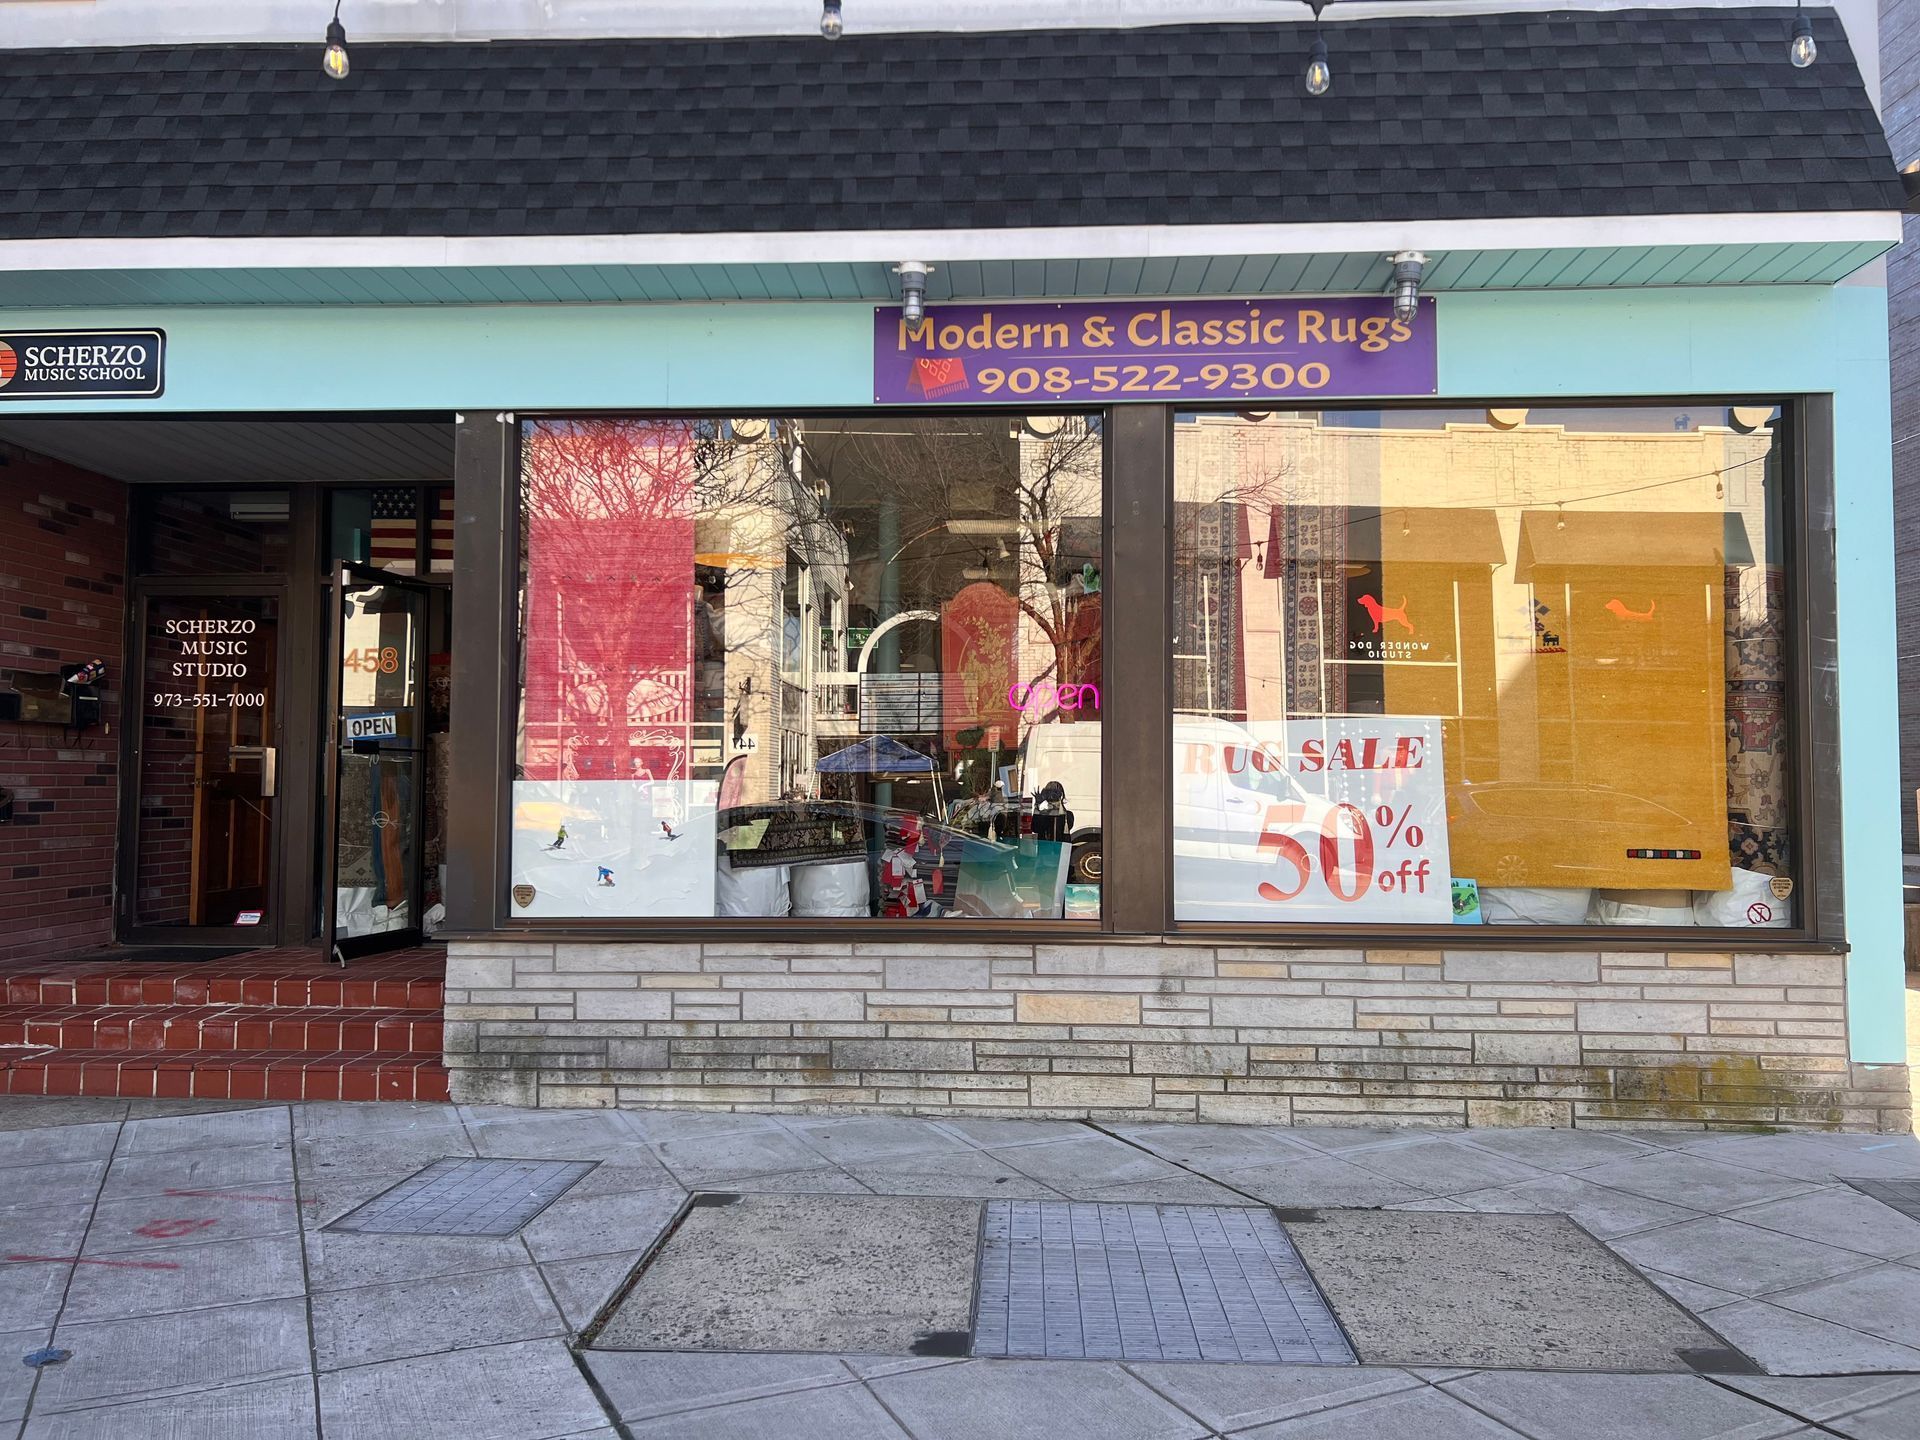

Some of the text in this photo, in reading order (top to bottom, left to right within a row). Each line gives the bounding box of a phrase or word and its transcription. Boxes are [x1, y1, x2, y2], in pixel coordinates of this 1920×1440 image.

[898, 309, 1412, 353] Modern & Classic Rugs
[24, 345, 147, 367] SCHERZO
[24, 367, 146, 381] MUSIC SCHOOL
[976, 362, 1331, 395] 908-522-9300
[165, 619, 256, 634] SCHERZO
[181, 640, 248, 656] MUSIC
[172, 662, 247, 679] STUDIO
[344, 646, 399, 674] 458
[154, 692, 265, 709] 973-551-7000
[352, 717, 393, 737] OPEN
[1181, 736, 1425, 775] RUG SALE
[1377, 859, 1431, 894] off
